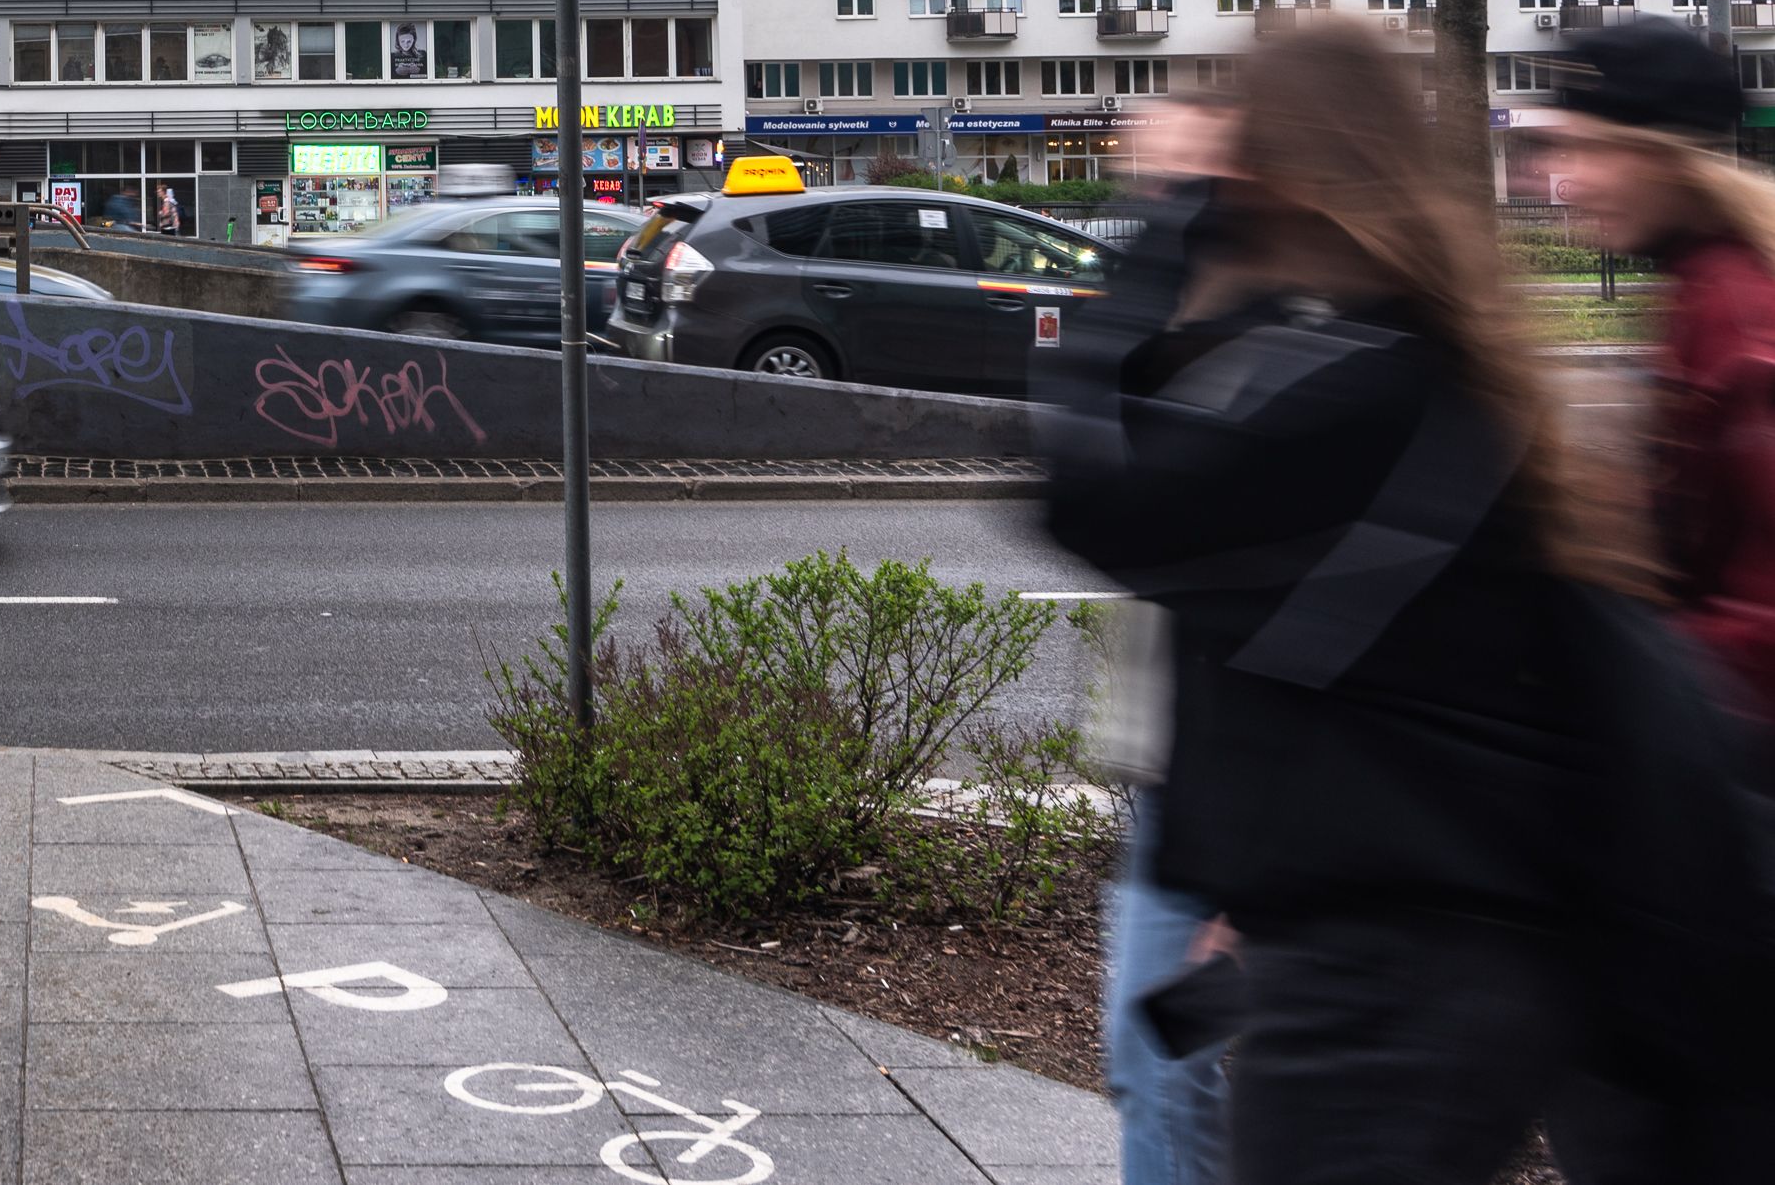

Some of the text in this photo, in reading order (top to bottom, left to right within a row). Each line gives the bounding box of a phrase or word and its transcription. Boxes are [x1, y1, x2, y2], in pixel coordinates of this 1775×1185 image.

[286, 111, 428, 130] LOOMBARD
[606, 104, 675, 127] KEBAB
[763, 121, 869, 131] Modelowanie sylwetki
[966, 120, 1020, 129] estetyczna
[1051, 119, 1081, 127] Klinika
[1110, 118, 1147, 126] Centrum
[594, 180, 621, 191] KEBAB
